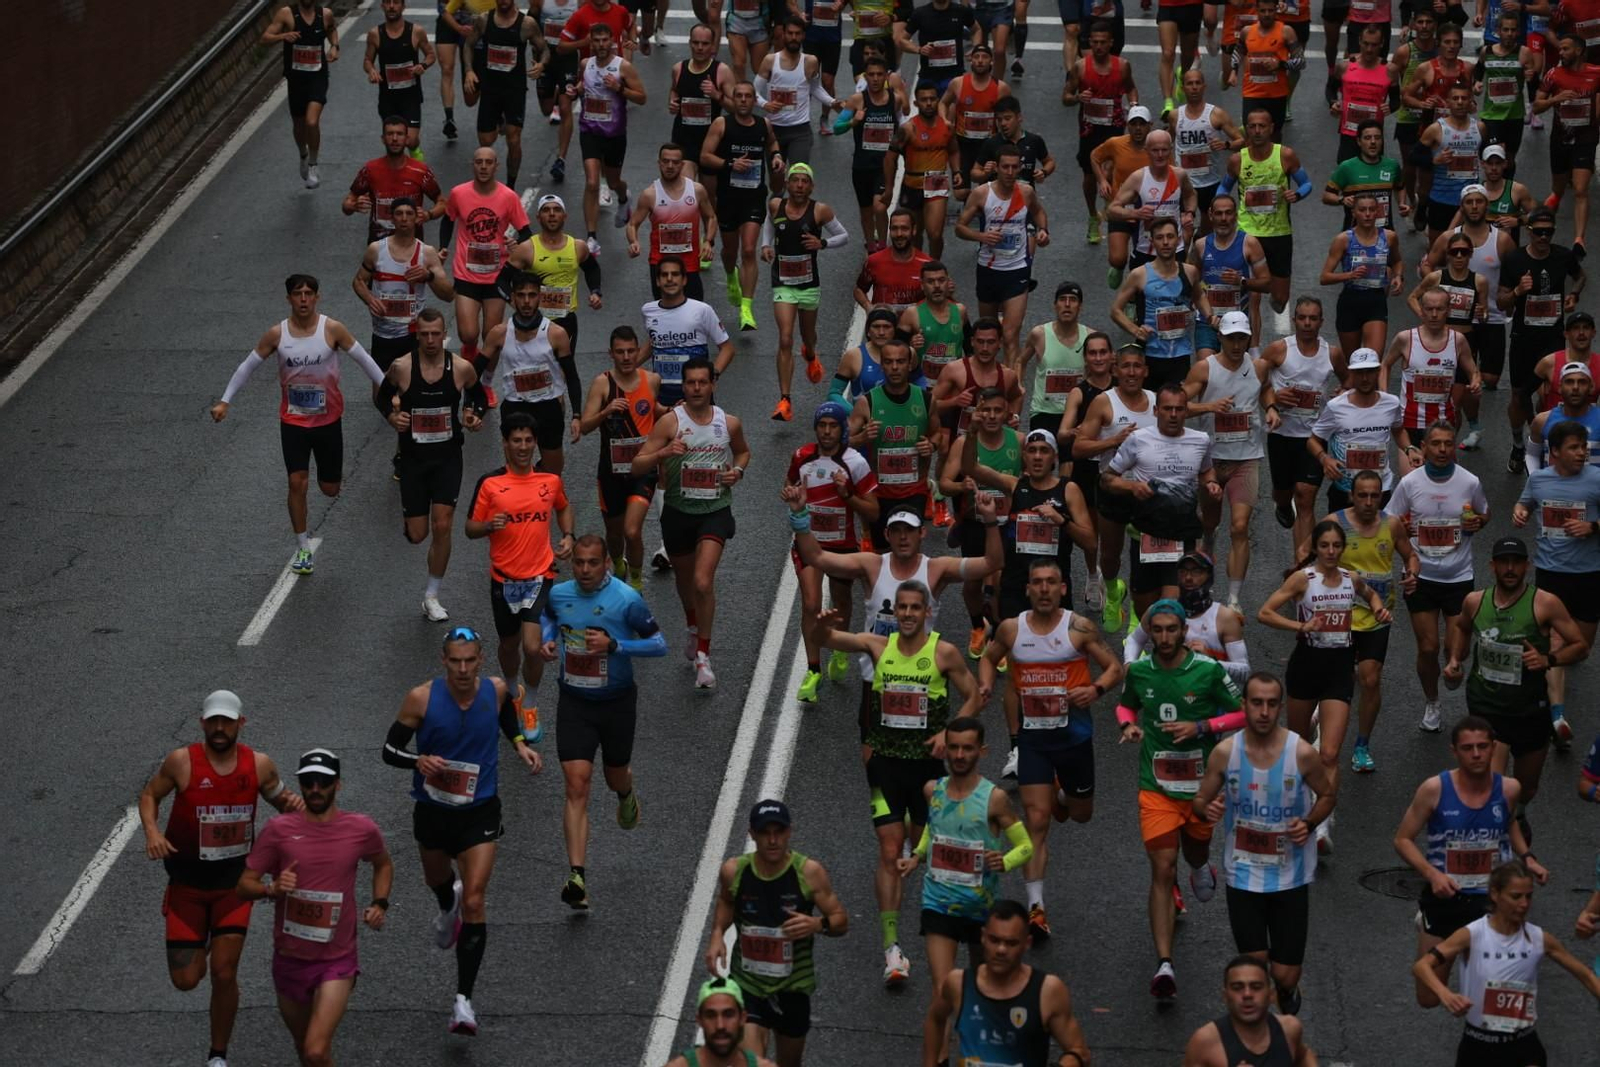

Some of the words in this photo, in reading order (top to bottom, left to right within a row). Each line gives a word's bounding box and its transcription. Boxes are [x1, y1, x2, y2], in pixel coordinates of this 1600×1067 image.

[1180, 130, 1207, 145] ENA
[292, 353, 322, 367] Salud
[884, 425, 919, 440] ADN
[1325, 612, 1346, 625] 797
[297, 903, 324, 919] 253
[1496, 993, 1524, 1011] 974
